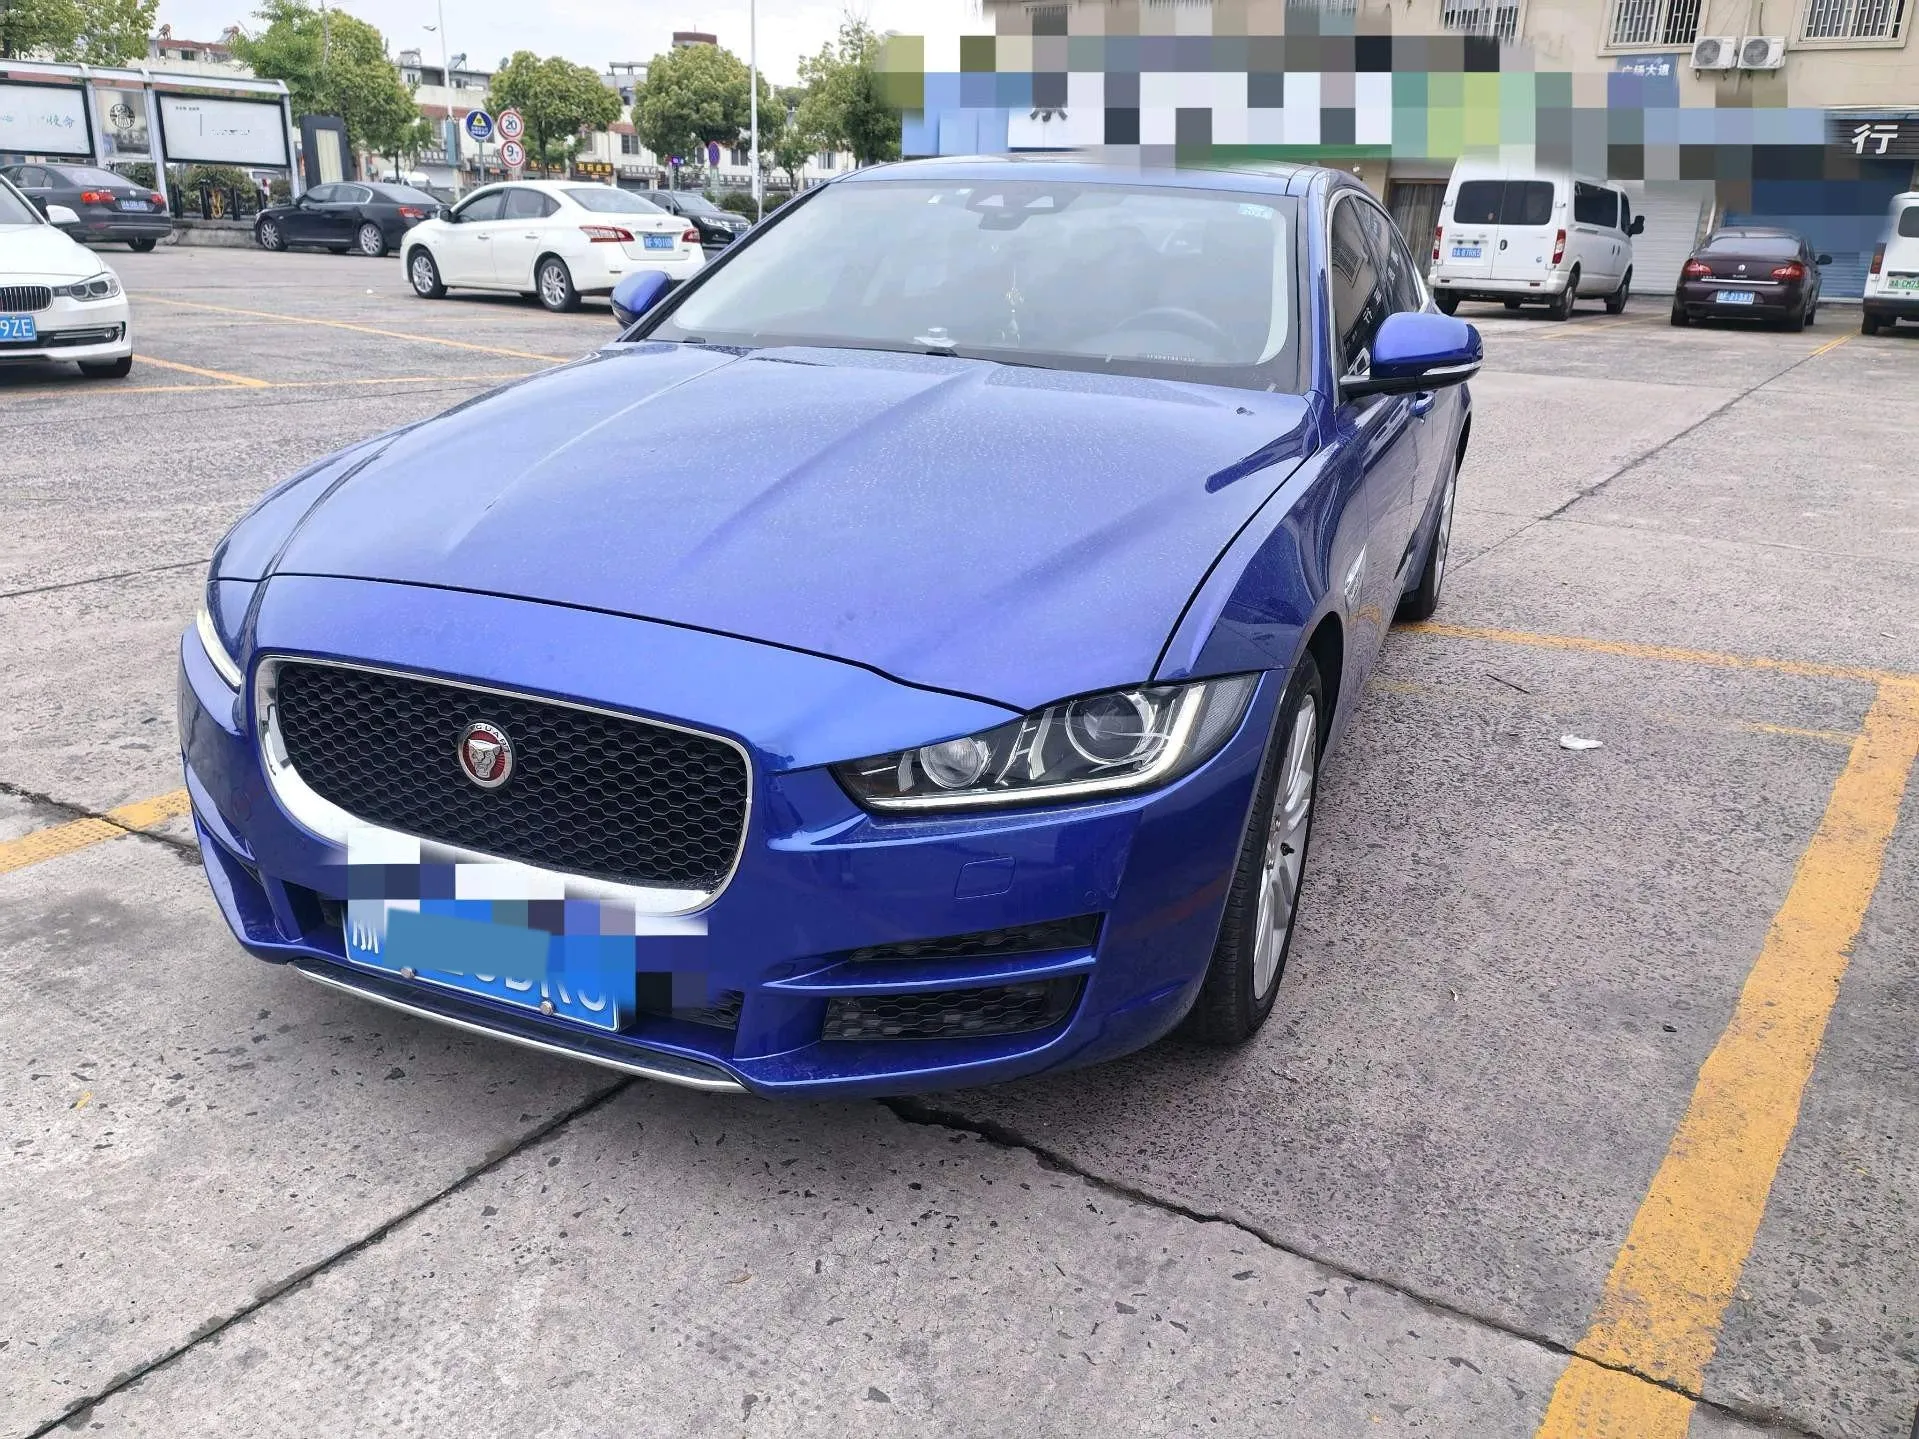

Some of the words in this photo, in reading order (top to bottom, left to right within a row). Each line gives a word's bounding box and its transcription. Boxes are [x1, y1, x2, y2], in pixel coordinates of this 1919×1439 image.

[505, 119, 518, 130] 20
[1851, 123, 1899, 155] 行
[0, 318, 33, 337] 9ZE
